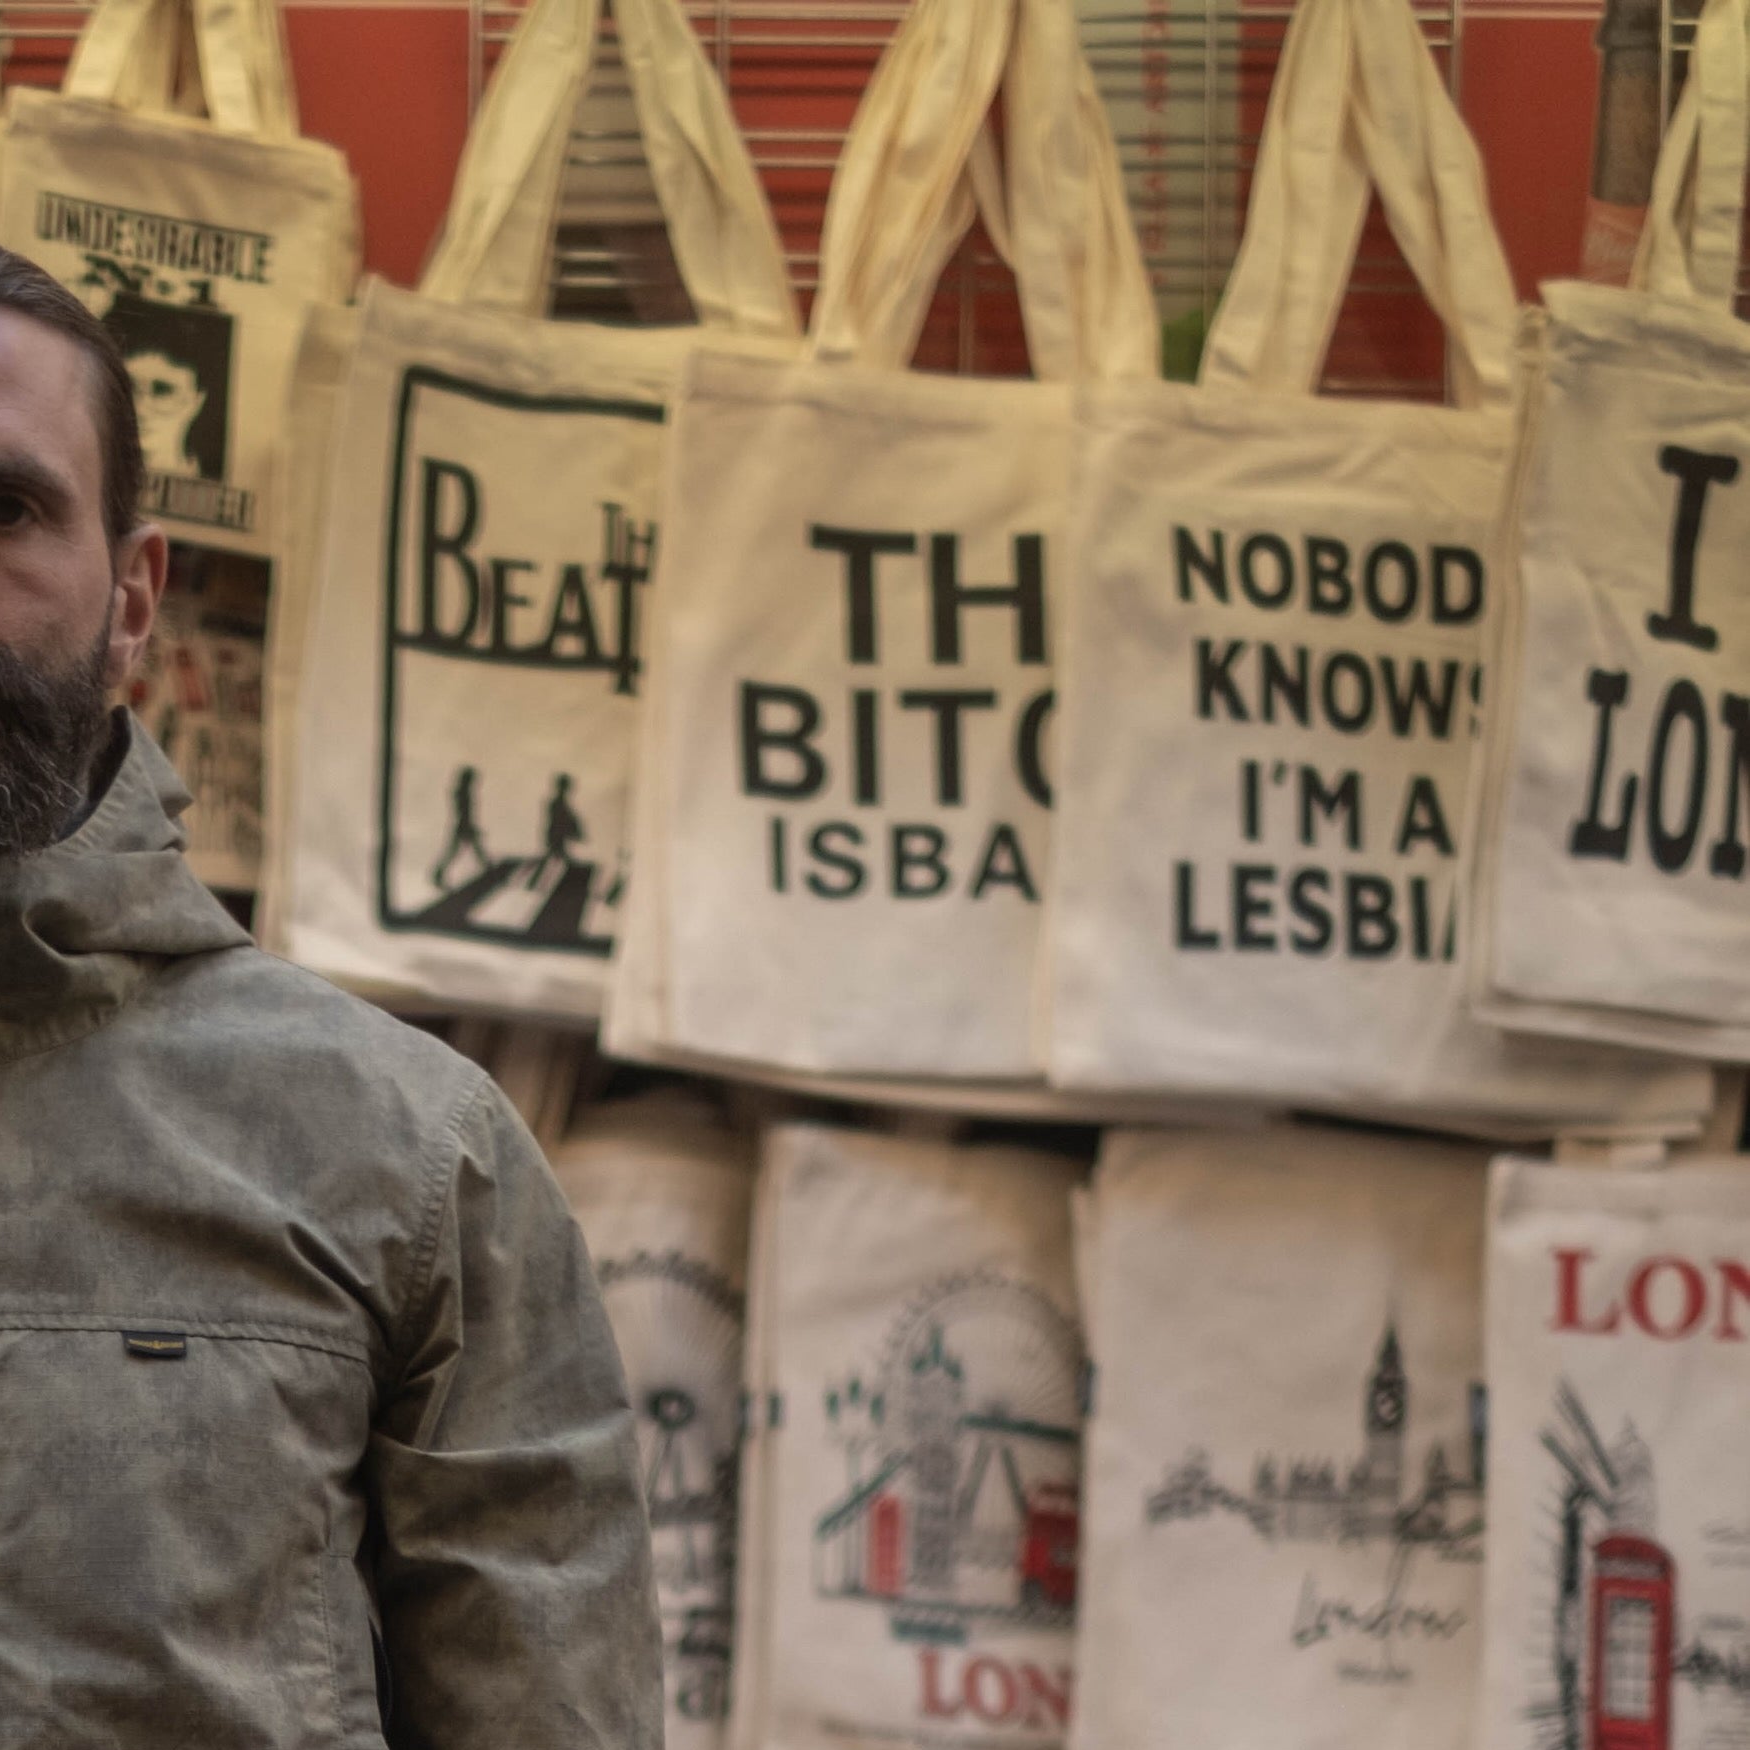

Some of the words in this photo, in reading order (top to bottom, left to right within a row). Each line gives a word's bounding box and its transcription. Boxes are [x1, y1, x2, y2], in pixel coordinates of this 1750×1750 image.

[807, 522, 1048, 667] TH
[1173, 525, 1484, 627] NOBOD
[1646, 444, 1739, 653] I
[1174, 860, 1457, 964] LESBI
